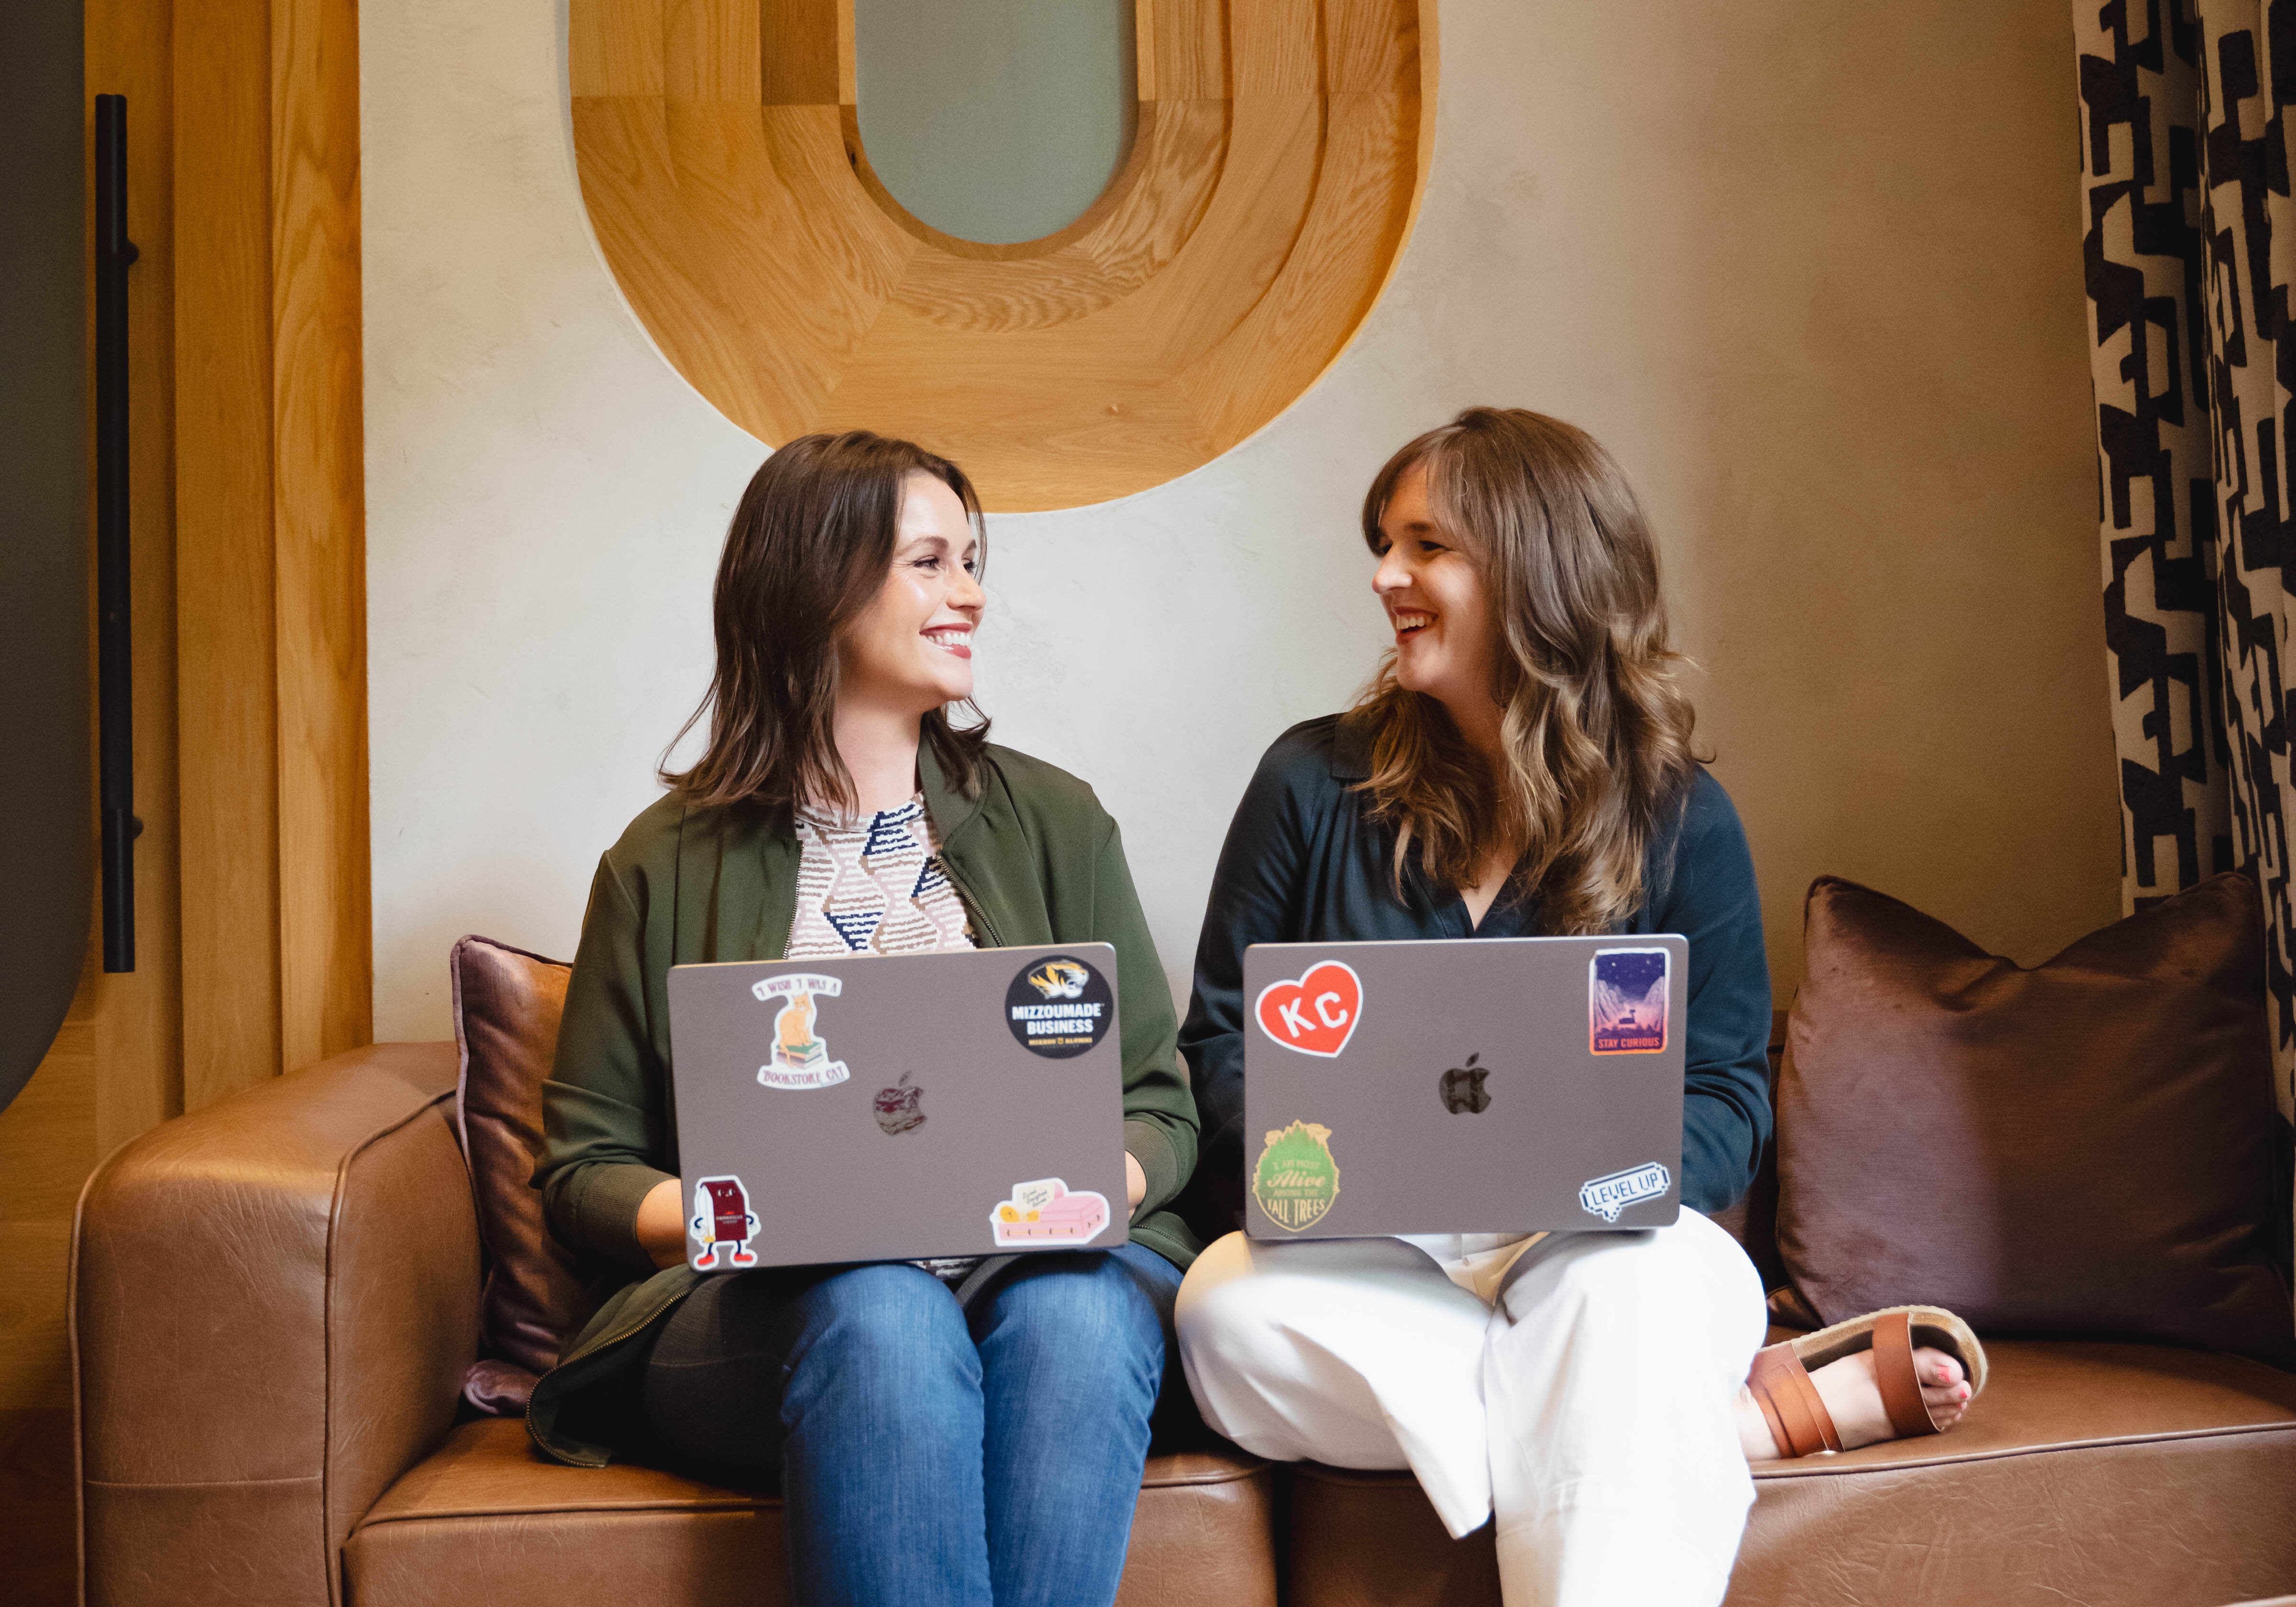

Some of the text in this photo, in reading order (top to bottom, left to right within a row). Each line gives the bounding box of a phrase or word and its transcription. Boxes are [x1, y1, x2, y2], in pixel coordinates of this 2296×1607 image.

[1012, 1003, 1102, 1020] MIZZOUMADE
[1278, 991, 1348, 1038] KC
[1027, 1019, 1093, 1035] BUSINESS
[1598, 1037, 1660, 1048] STAY CURIOUS
[763, 1067, 844, 1084] BOOKSTORE CAT
[1268, 1169, 1326, 1187] Alive
[1592, 1173, 1658, 1205] LEVEL UP
[1268, 1199, 1325, 1226] TALL TREES
